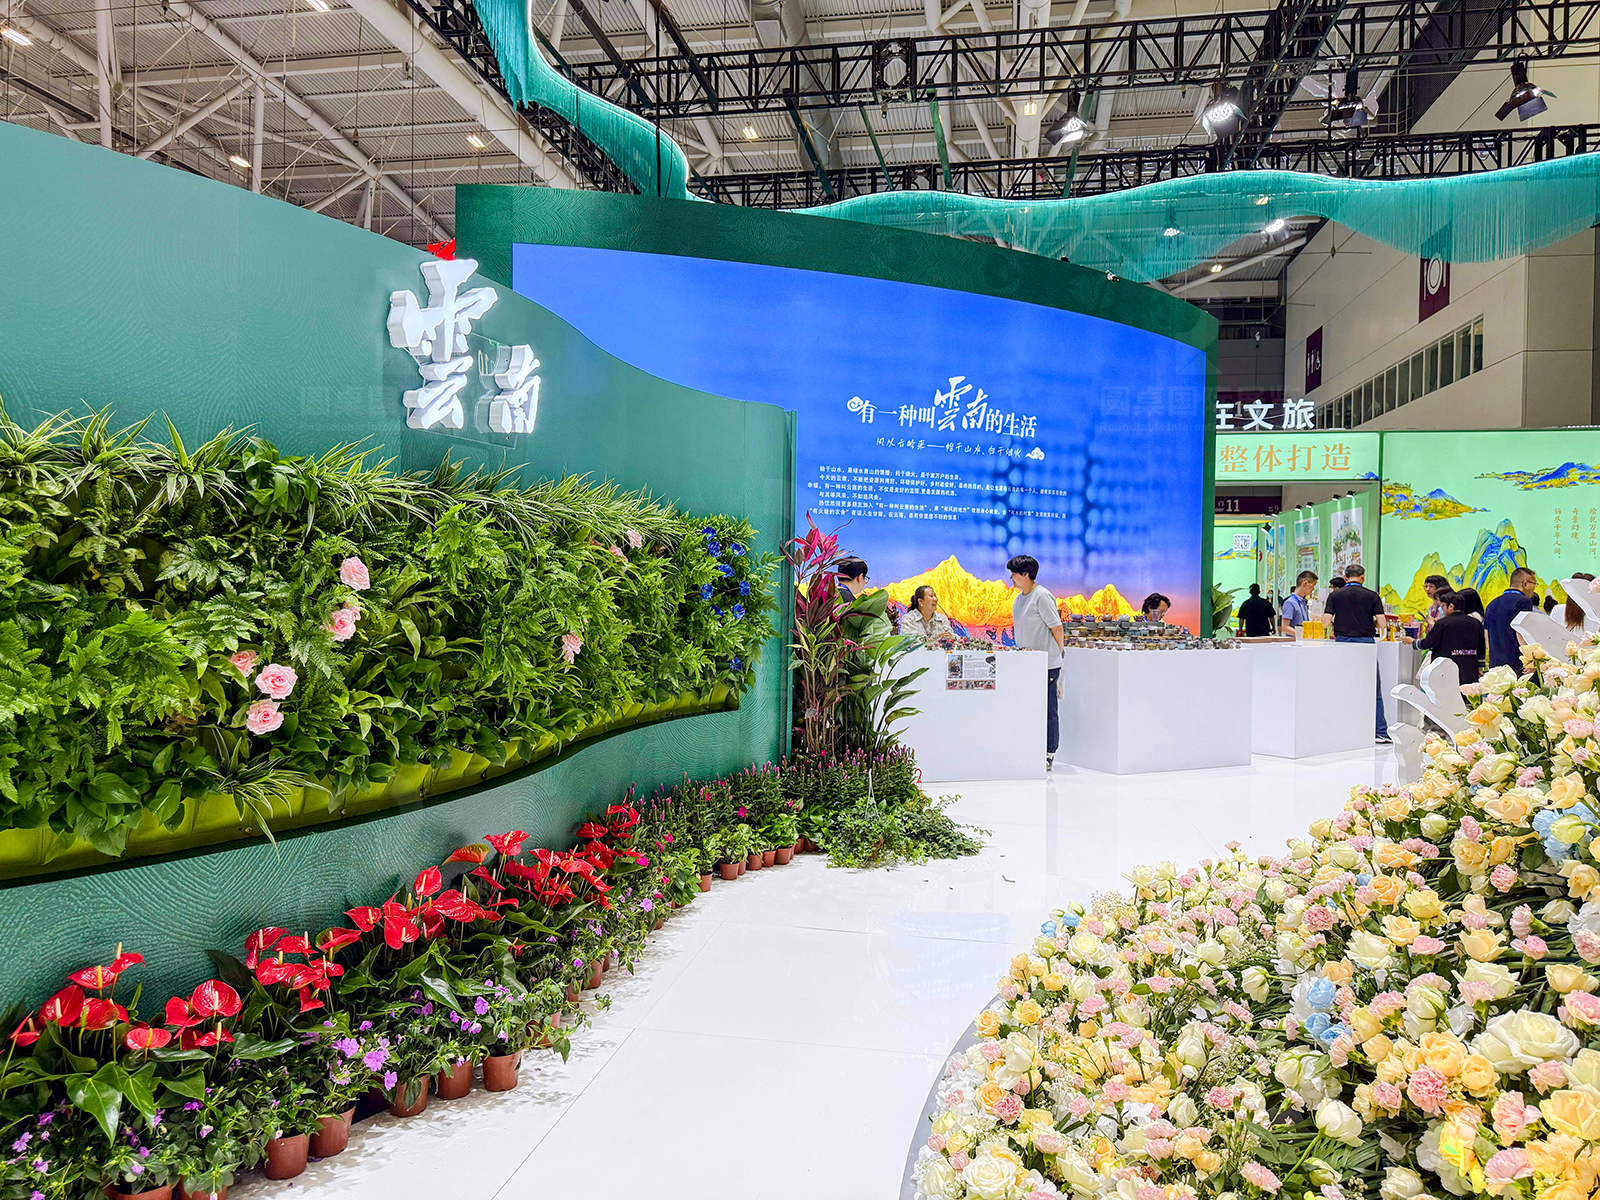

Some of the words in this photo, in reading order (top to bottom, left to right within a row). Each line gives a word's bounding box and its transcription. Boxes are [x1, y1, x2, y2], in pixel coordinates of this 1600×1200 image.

[1219, 443, 1351, 473] 整体打造
[1226, 499, 1240, 512] 11
